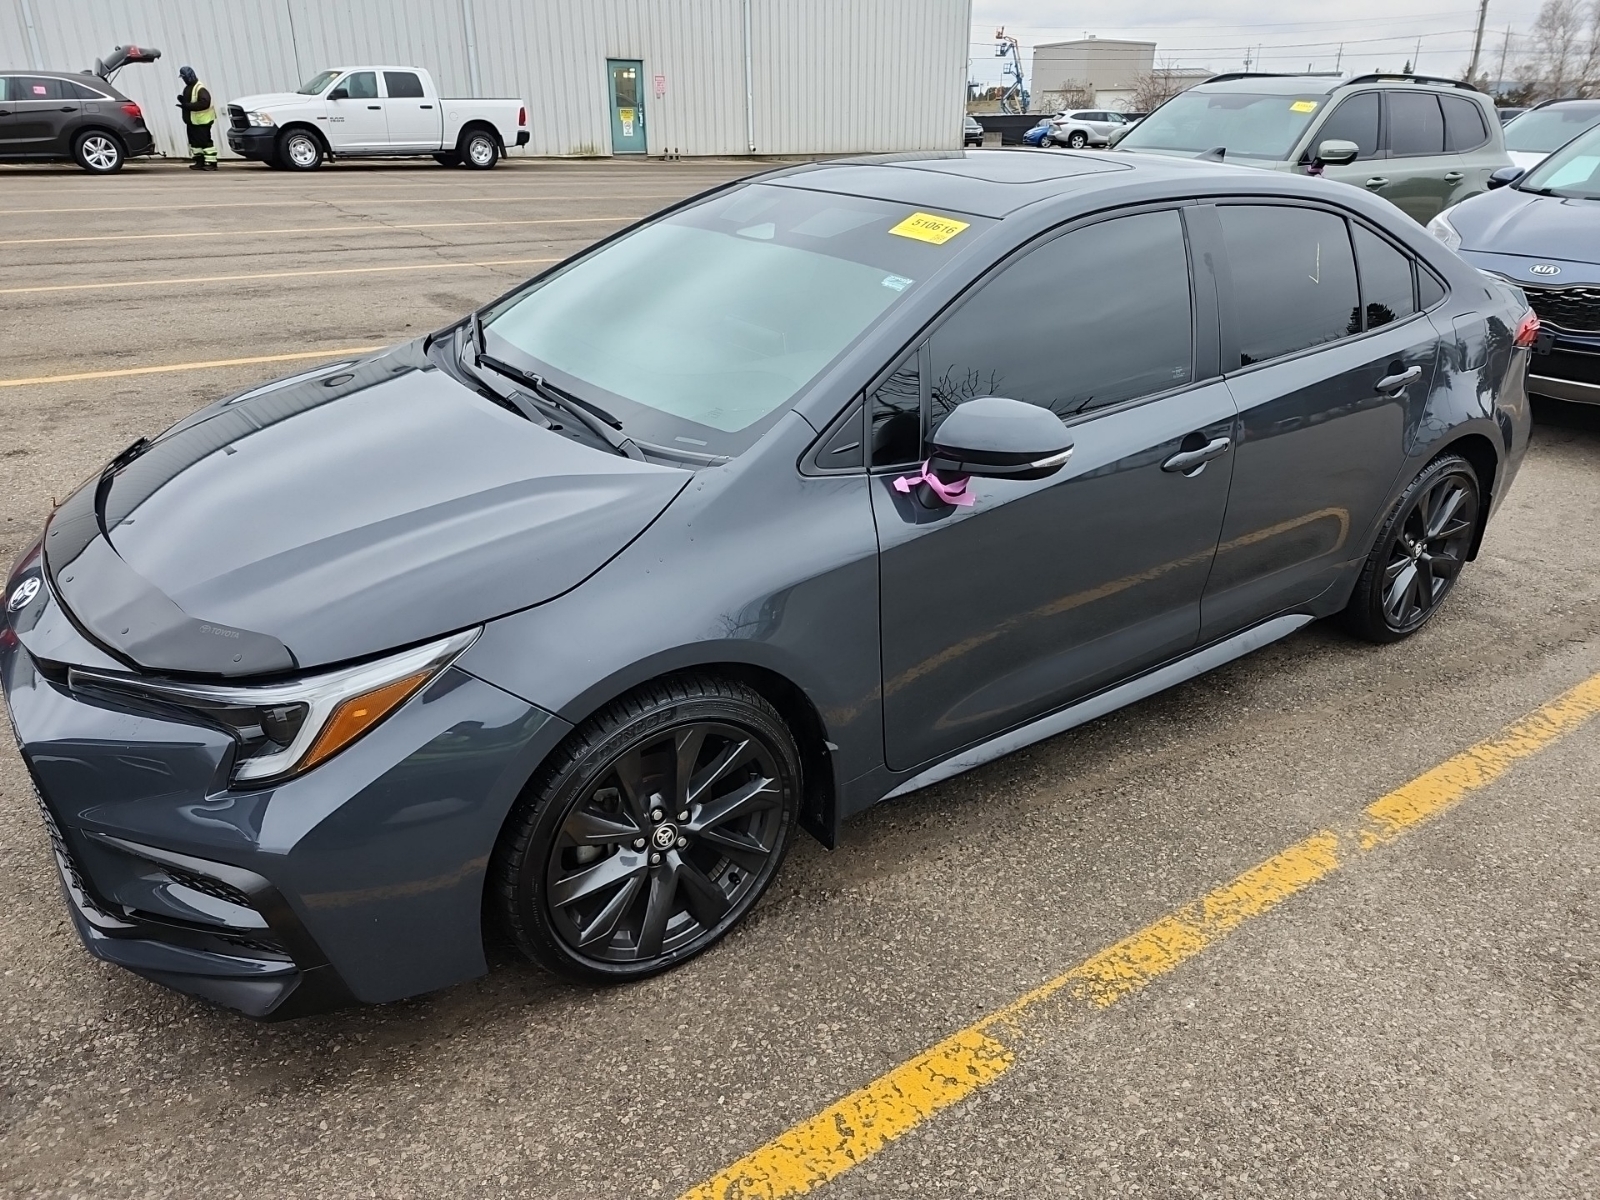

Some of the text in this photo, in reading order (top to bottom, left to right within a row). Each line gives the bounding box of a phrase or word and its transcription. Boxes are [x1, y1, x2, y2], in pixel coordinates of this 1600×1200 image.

[911, 218, 958, 234] 510616
[1533, 265, 1555, 274] KIA
[210, 627, 240, 639] TOYOTA
[598, 710, 673, 758] DUNLOP
